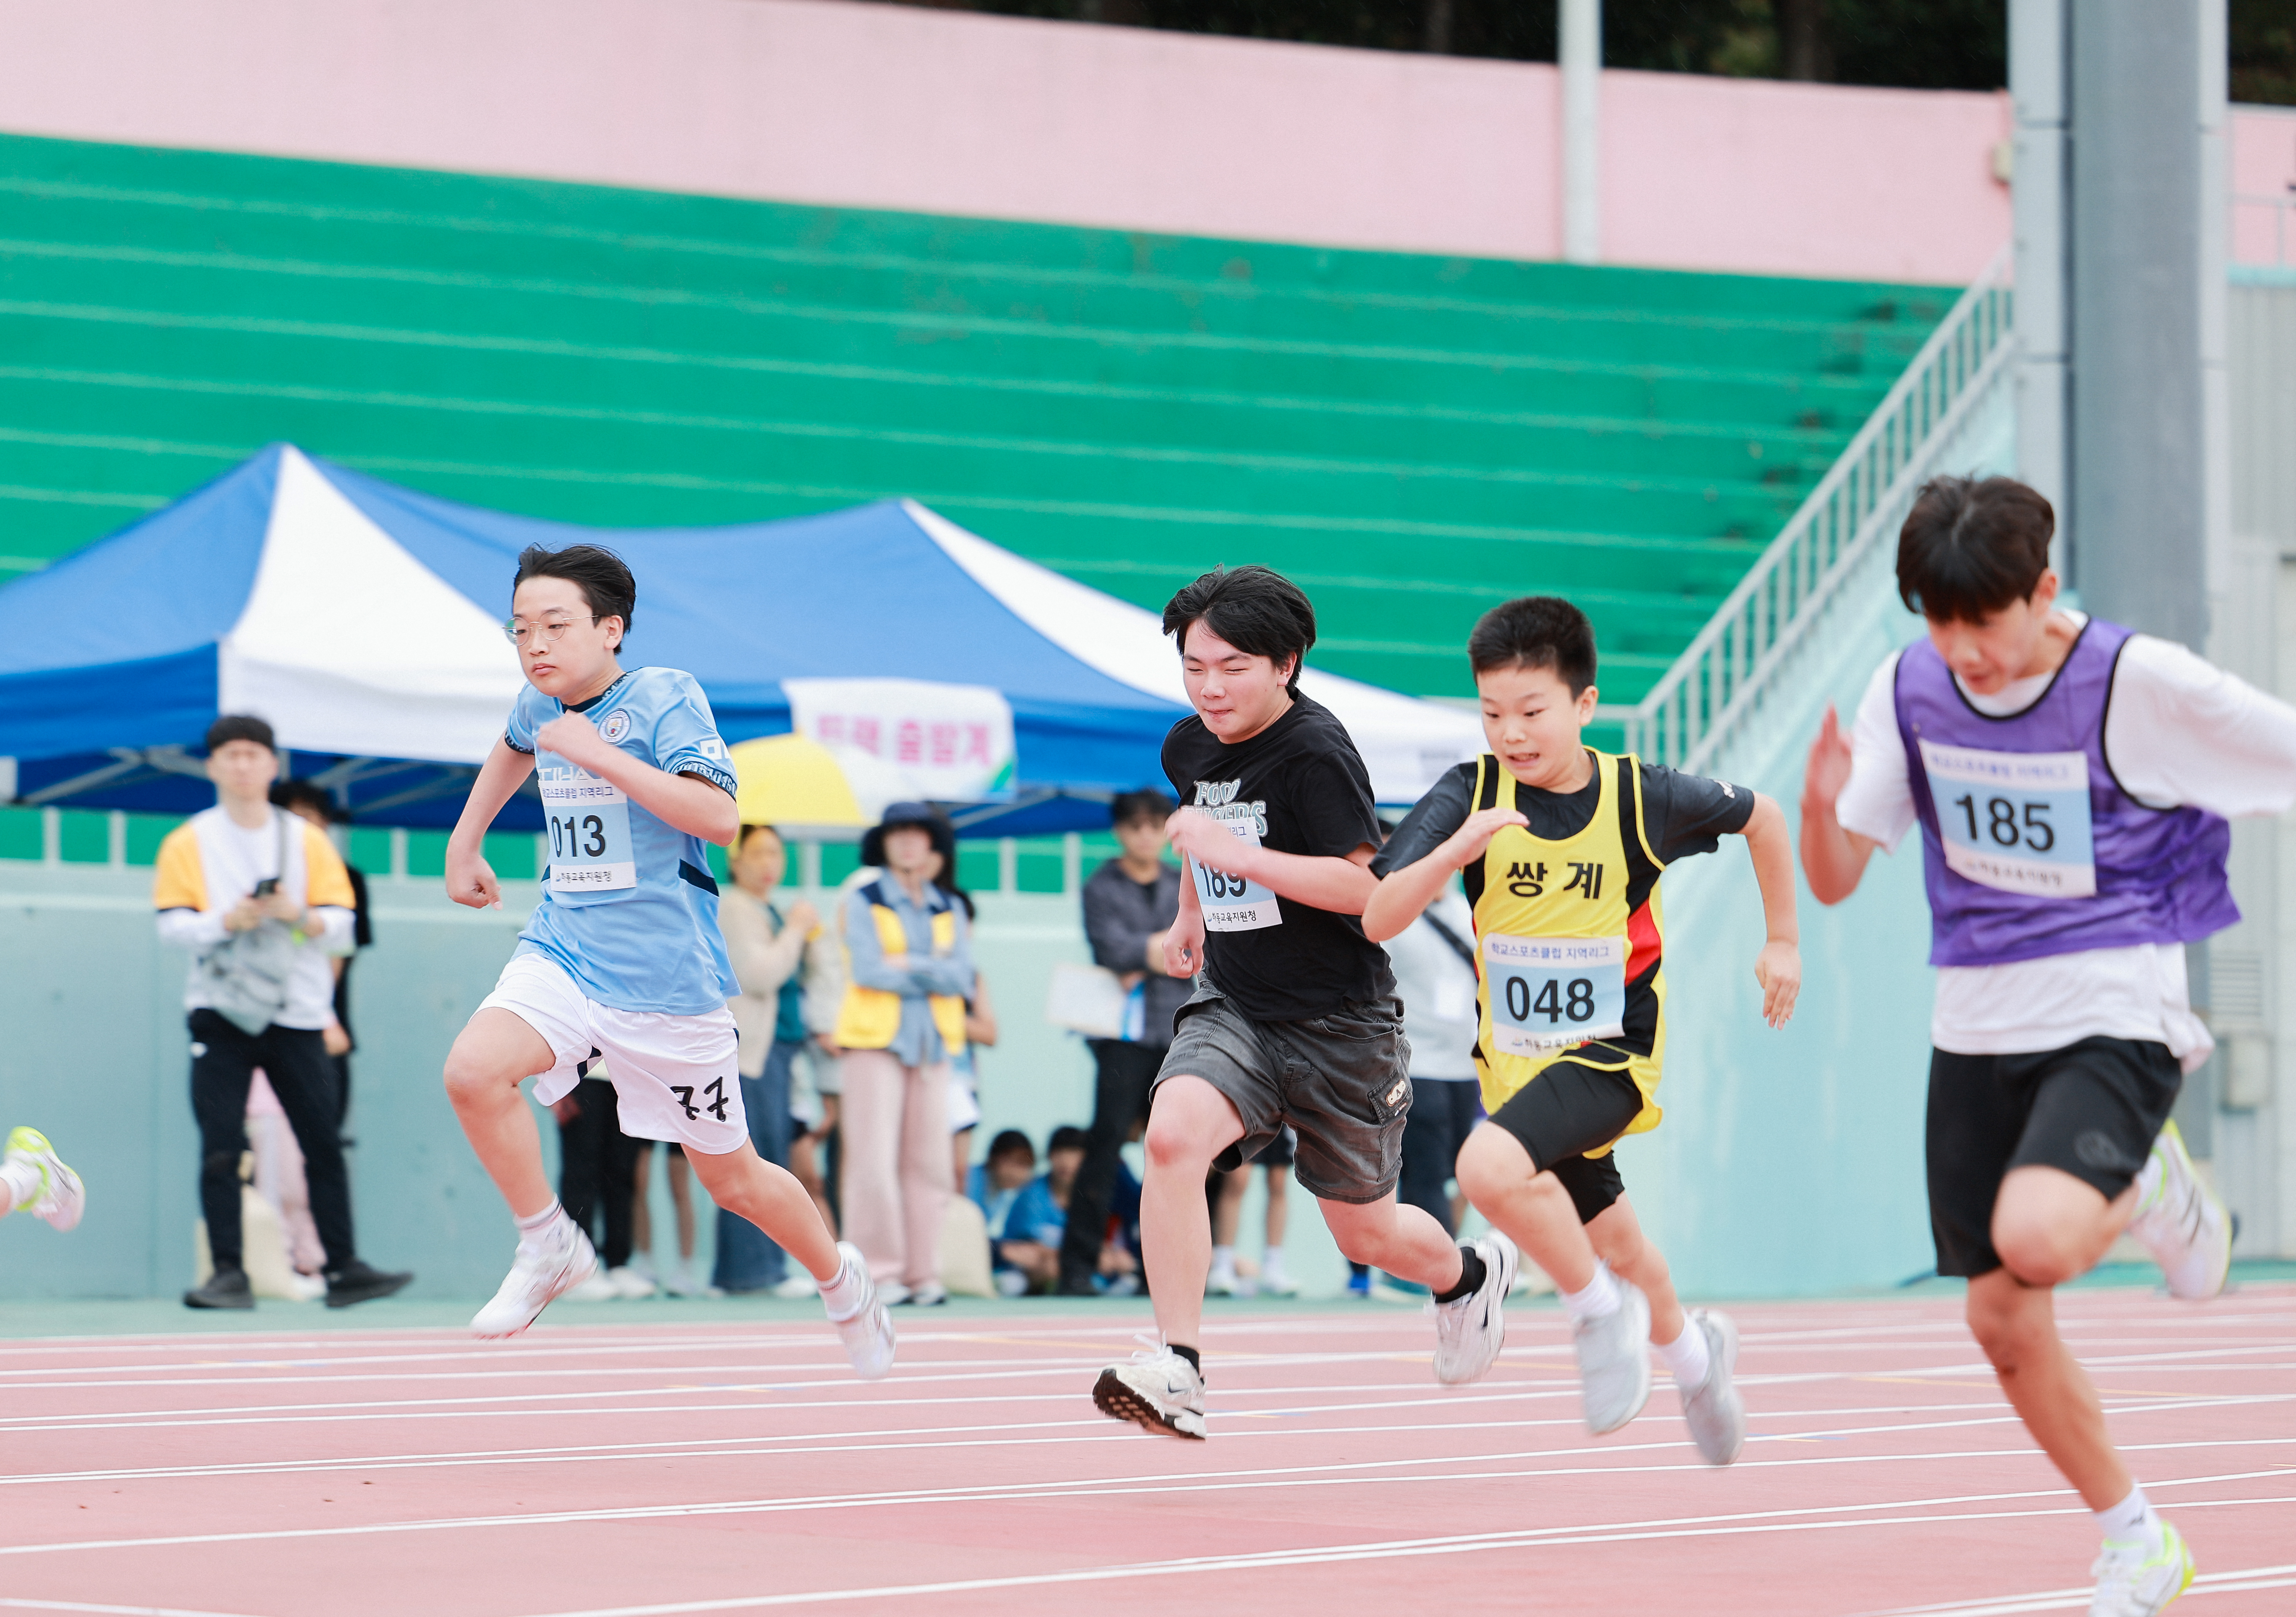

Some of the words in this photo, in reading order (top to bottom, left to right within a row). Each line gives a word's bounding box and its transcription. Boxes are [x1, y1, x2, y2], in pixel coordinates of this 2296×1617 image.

[579, 786, 614, 798] 지역리그
[552, 815, 605, 857] 013
[1955, 794, 2054, 852] 185
[1199, 861, 1246, 898] 189
[1212, 910, 1256, 924] 하동교육지원청
[1491, 943, 1561, 959] 학교스포츠클럽
[1567, 946, 1609, 960] 지역리그
[1506, 976, 1595, 1023] 048
[670, 1076, 729, 1122] 77
